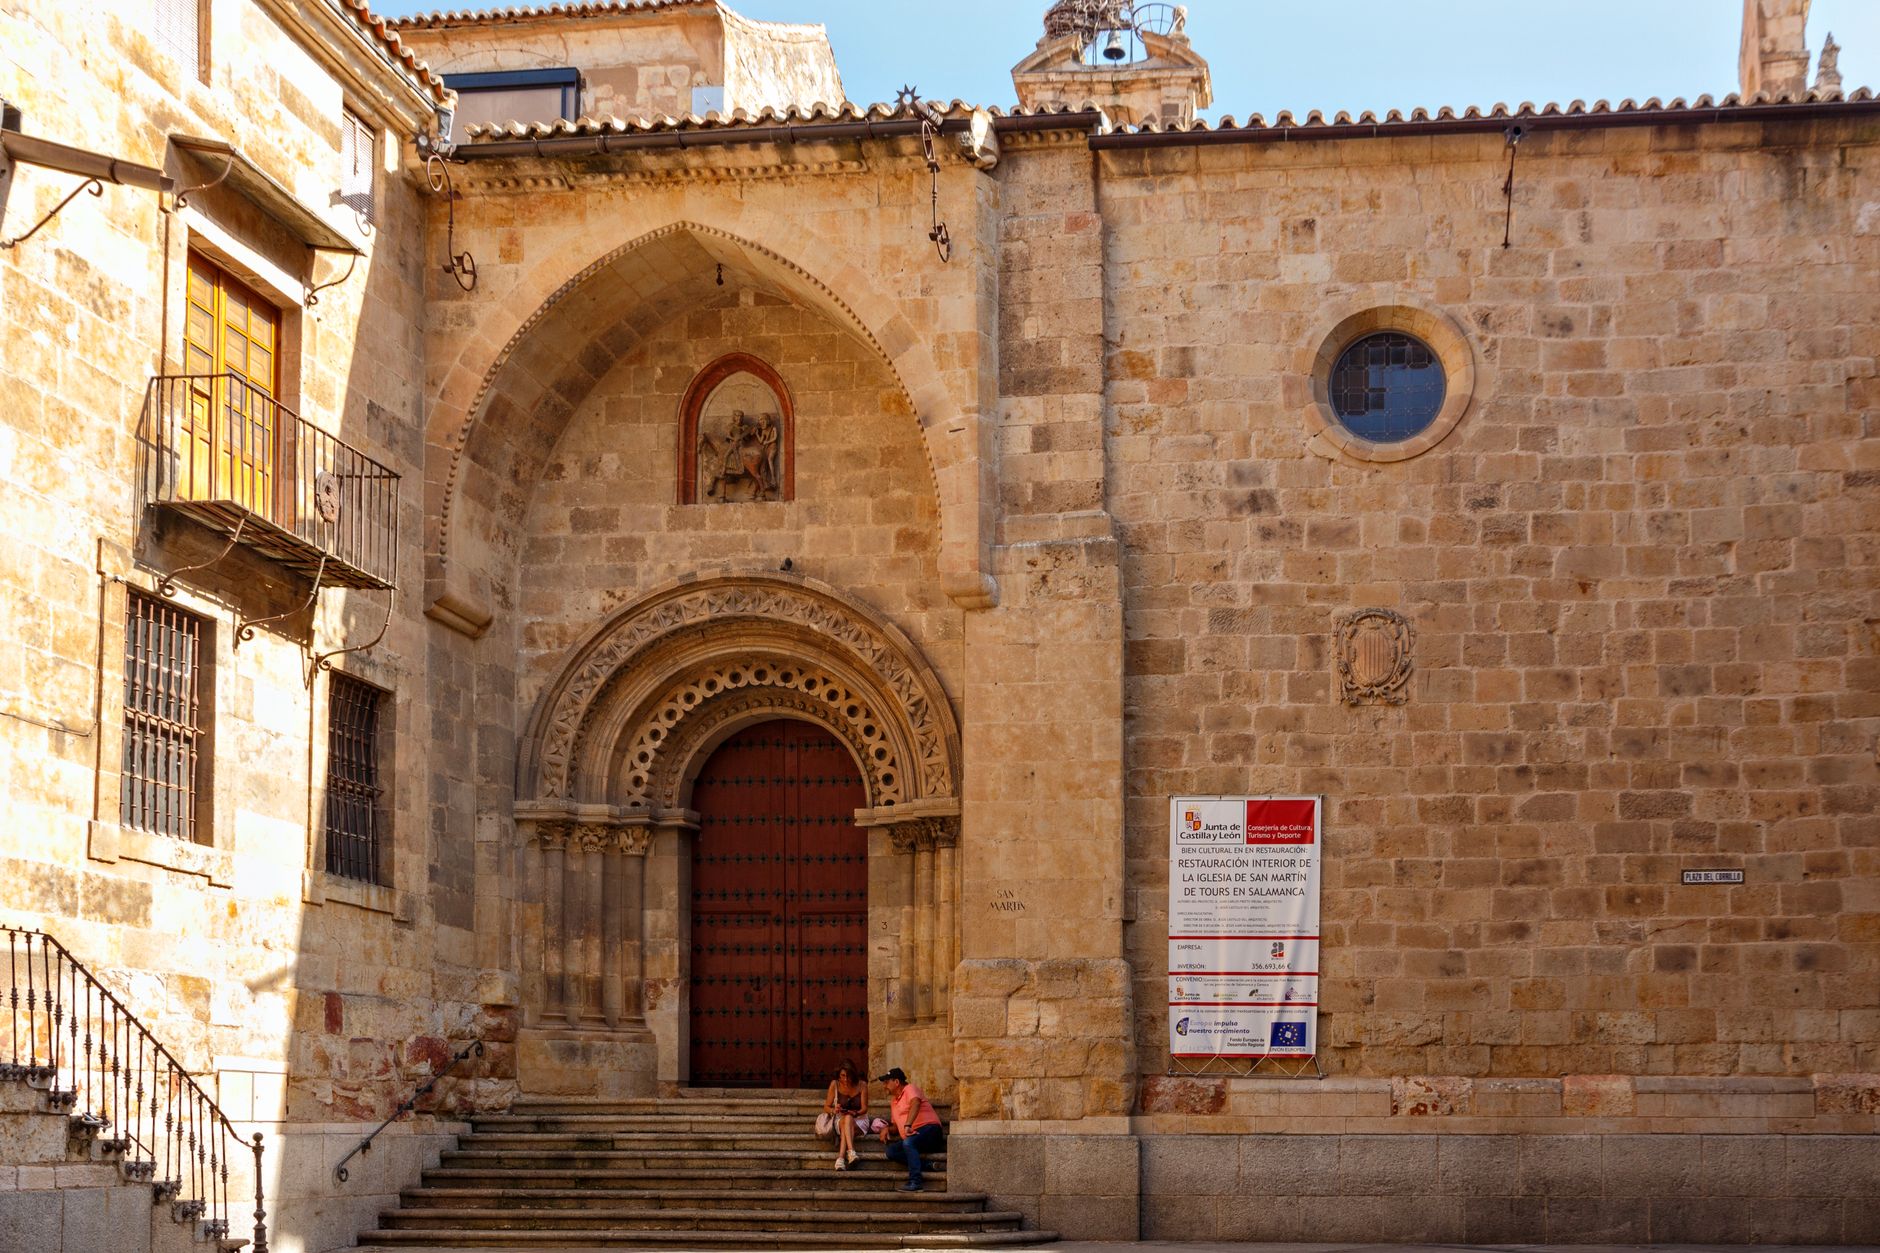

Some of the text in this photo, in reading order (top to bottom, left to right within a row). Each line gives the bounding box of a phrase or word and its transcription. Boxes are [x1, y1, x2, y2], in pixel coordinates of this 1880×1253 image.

[1219, 831, 1241, 839] León
[1178, 857, 1311, 867] RESTAURACIÓN INTERIOR DE
[1183, 871, 1307, 882] LA IGLESIA DE SAN MARTÍN
[997, 890, 1014, 898] SAN
[1184, 888, 1305, 896] DE TOURS EN SALAMANCA
[988, 901, 1025, 912] MARTIN
